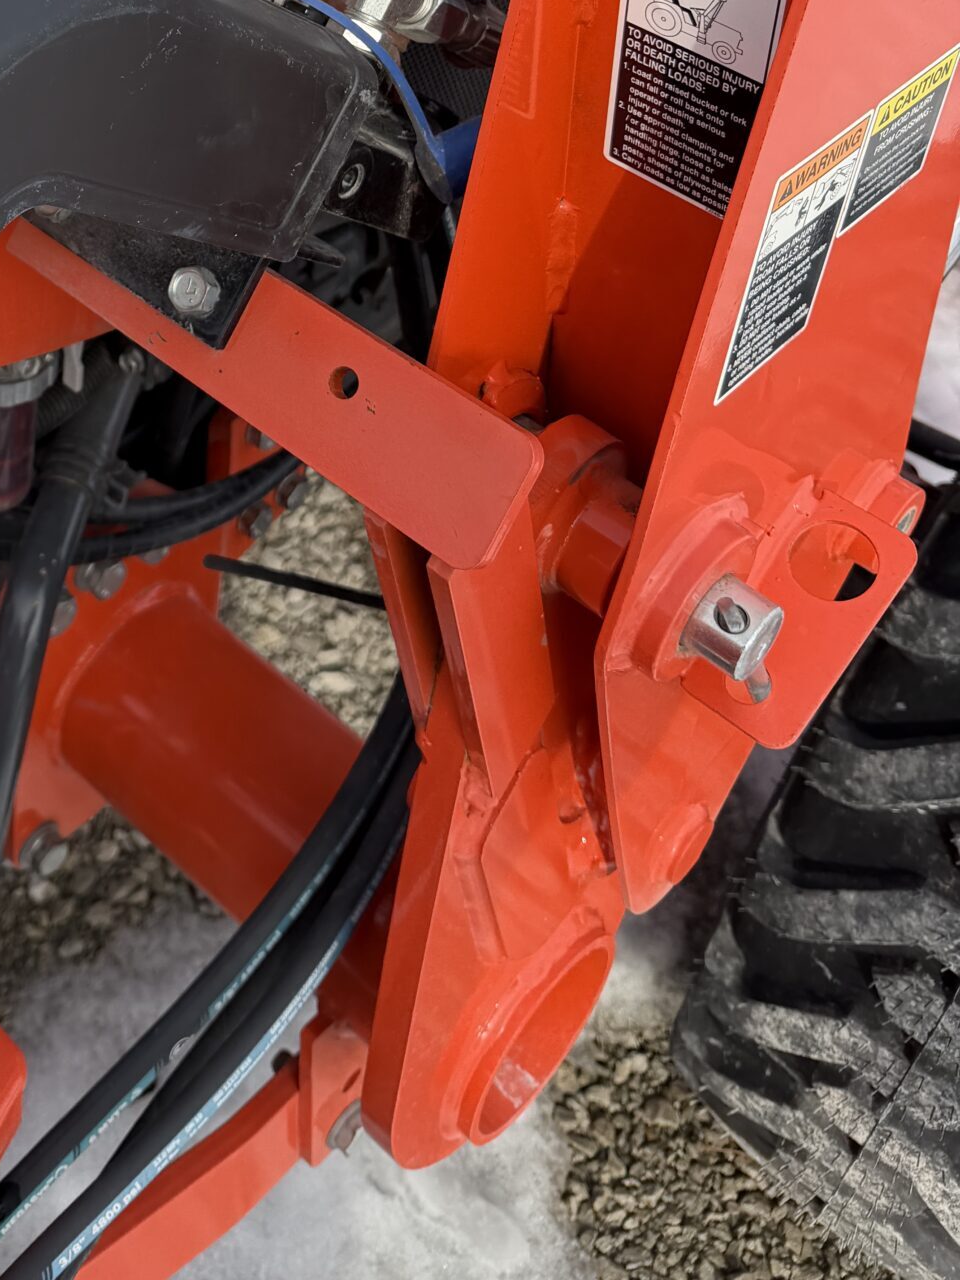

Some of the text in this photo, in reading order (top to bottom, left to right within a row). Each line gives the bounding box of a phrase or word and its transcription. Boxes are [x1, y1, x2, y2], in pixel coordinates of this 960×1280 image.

[625, 48, 706, 93] FALLING LOADS:
[627, 38, 736, 95] OR DEATH CAUSED BY
[628, 26, 760, 94] TO AVOID SERIOUS INJURY
[624, 62, 629, 70] 1.
[632, 65, 652, 80] Load
[653, 77, 663, 86] on
[665, 83, 689, 99] raised
[691, 94, 718, 113] bucket
[730, 113, 747, 127] fork
[631, 77, 644, 88] can
[647, 83, 658, 94] fall
[670, 96, 683, 106] roll
[685, 102, 704, 117] back
[706, 113, 724, 126] onto
[894, 59, 952, 113] CAUTION
[618, 100, 734, 163] 2. Use approved clamping and
[628, 95, 650, 112] injury
[662, 113, 685, 129] death.
[630, 87, 725, 138] operator causing serious
[879, 128, 889, 140] TO
[888, 112, 910, 133] AVOID
[624, 135, 656, 155] shiftable
[657, 150, 678, 166] loads
[680, 163, 698, 177] such
[701, 174, 710, 183] as
[625, 124, 657, 147] handling
[682, 153, 704, 169] loose
[640, 123, 662, 138] guard
[664, 135, 711, 163] attachments
[713, 158, 724, 168] for
[796, 128, 862, 190] WARNING
[874, 133, 895, 156] FROM
[612, 148, 620, 156] 3.
[622, 152, 642, 168] Carry
[644, 163, 664, 179] loads
[666, 176, 675, 184] as
[677, 182, 690, 192] low
[648, 156, 672, 174] sheets
[683, 175, 716, 196] plywood
[752, 235, 811, 287] FROM FALLS OR
[756, 220, 818, 274] TO AVOID INJURY
[748, 275, 772, 299] BEING
[58, 1181, 142, 1268] 3/8" 4800 psi
